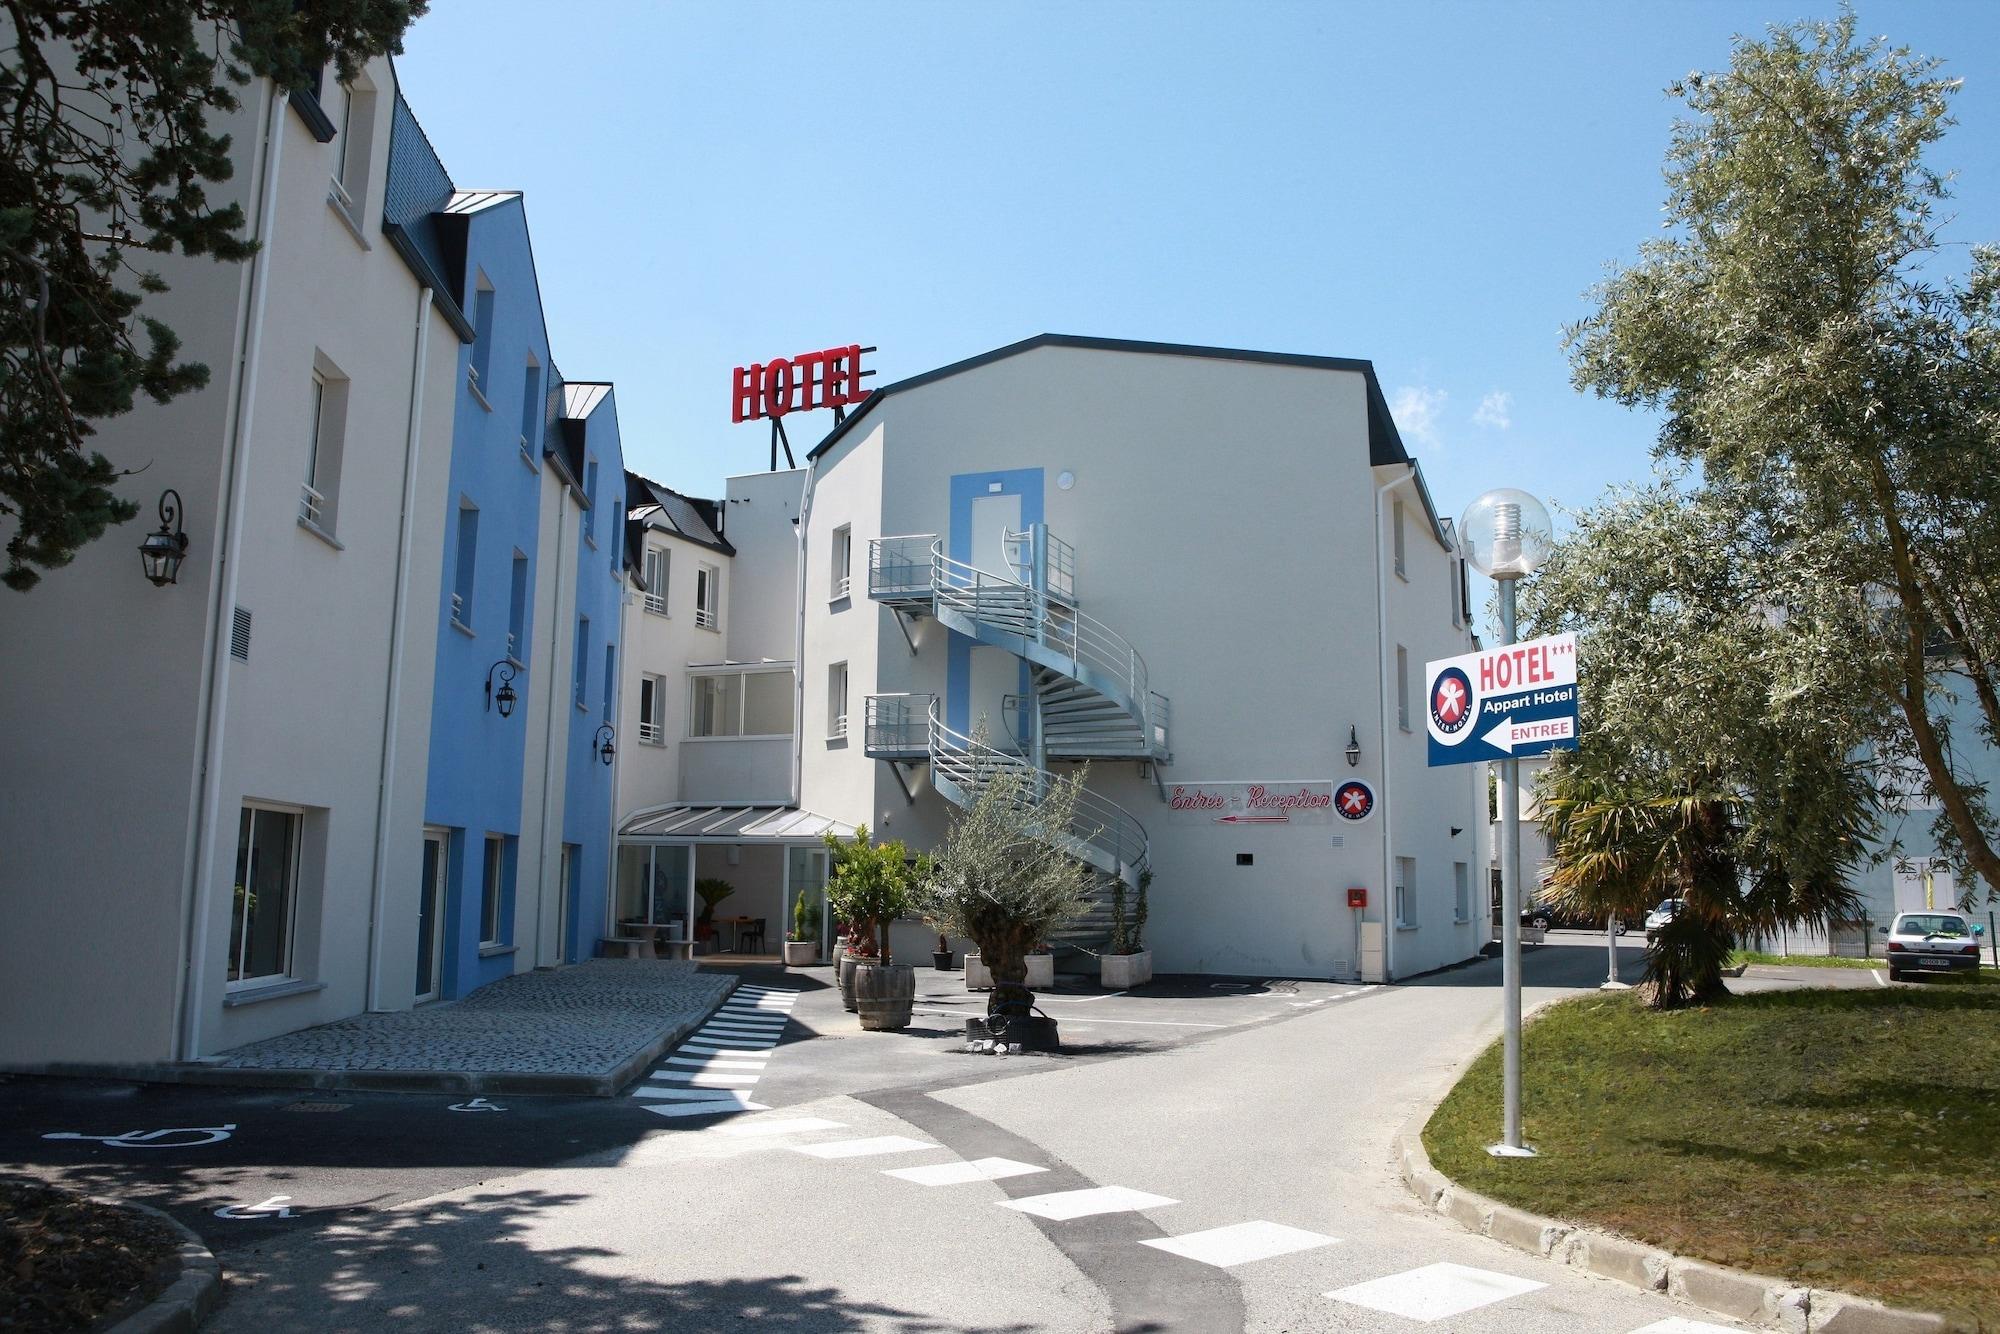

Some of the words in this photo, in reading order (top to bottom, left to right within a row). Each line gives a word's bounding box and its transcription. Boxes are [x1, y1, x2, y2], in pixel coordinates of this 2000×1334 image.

[732, 344, 874, 424] HOTEL
[1480, 645, 1554, 692] HOTEL
[1484, 695, 1530, 714] Appart
[1534, 688, 1573, 706] Hotel
[1432, 704, 1471, 732] INTER-HOTEL
[1511, 722, 1569, 740] ENTREE
